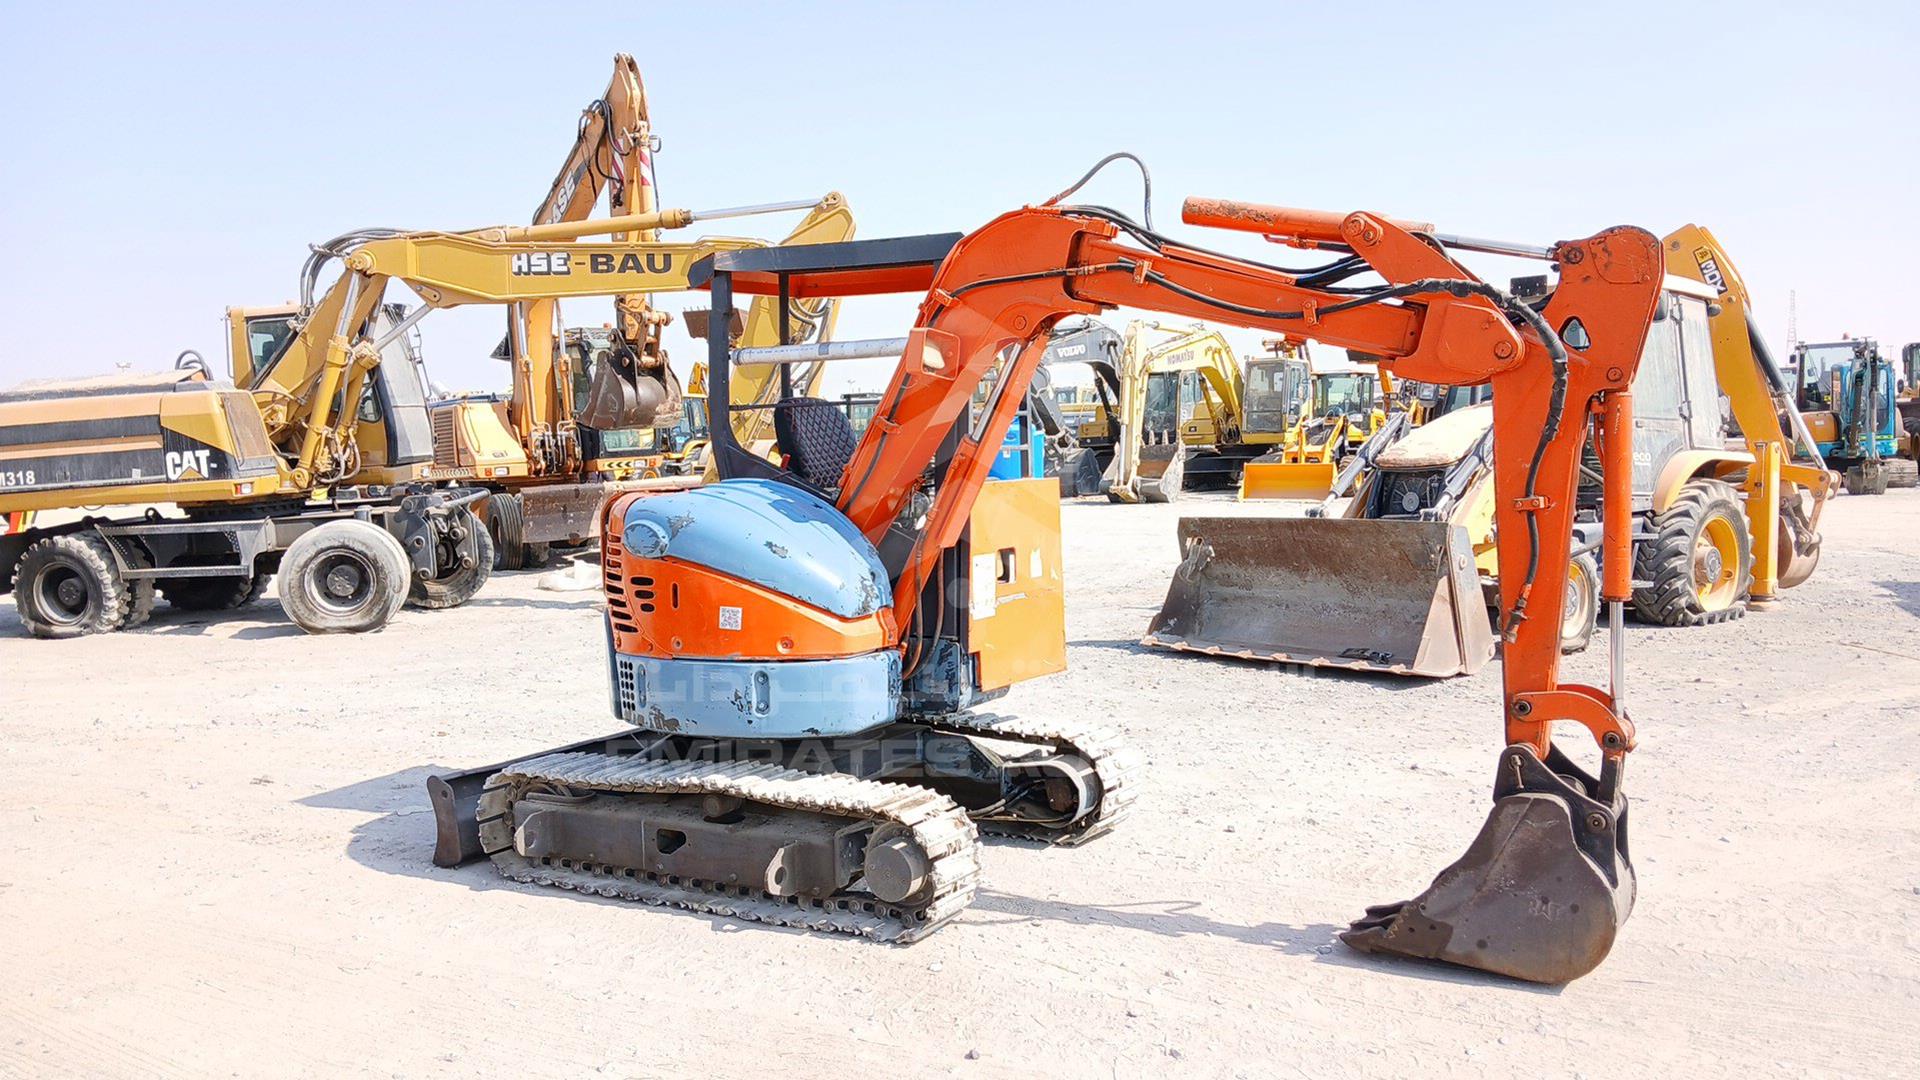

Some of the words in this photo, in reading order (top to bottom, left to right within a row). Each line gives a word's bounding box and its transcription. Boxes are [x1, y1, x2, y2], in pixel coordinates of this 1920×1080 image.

[545, 167, 577, 225] ASE
[1057, 344, 1087, 358] VOLVO
[166, 449, 210, 480] CAT
